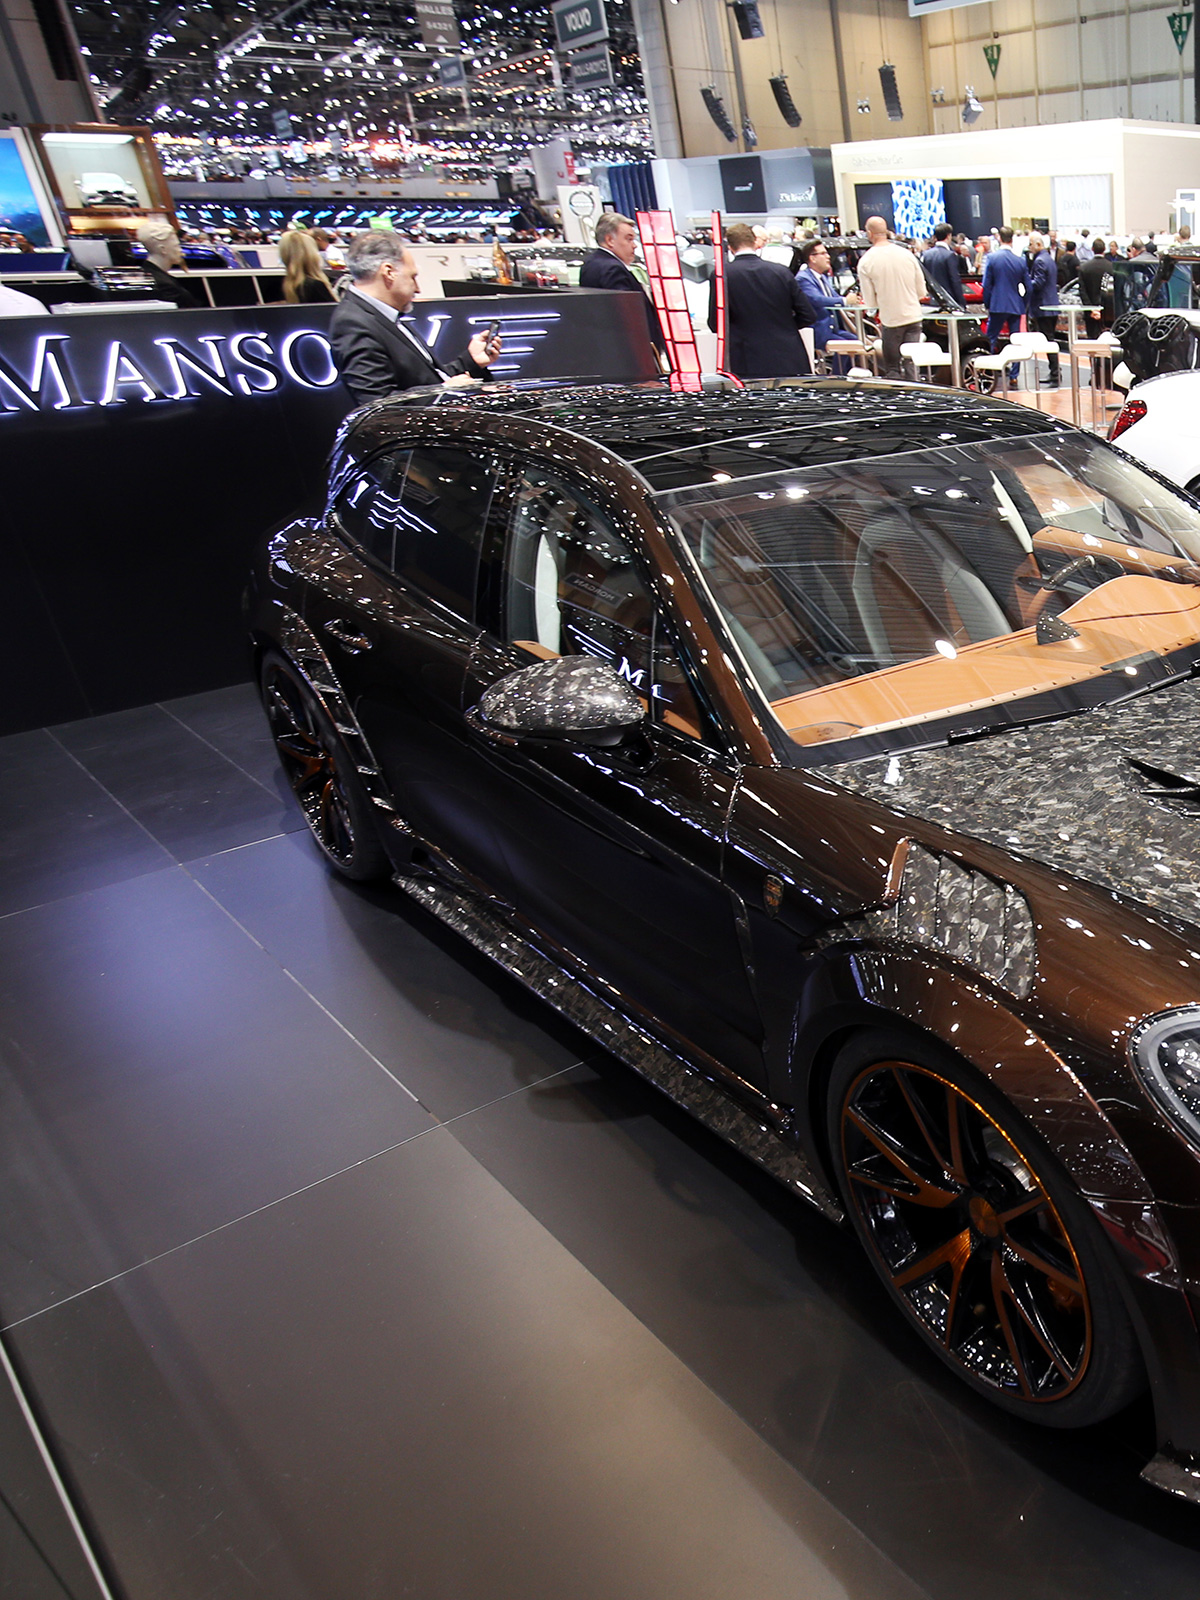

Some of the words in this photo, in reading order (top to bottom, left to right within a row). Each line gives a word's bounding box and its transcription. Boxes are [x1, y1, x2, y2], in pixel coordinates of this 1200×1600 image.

[565, 7, 592, 32] VOLVO
[1063, 199, 1092, 211] DAWN
[0, 313, 452, 413] MANSO
